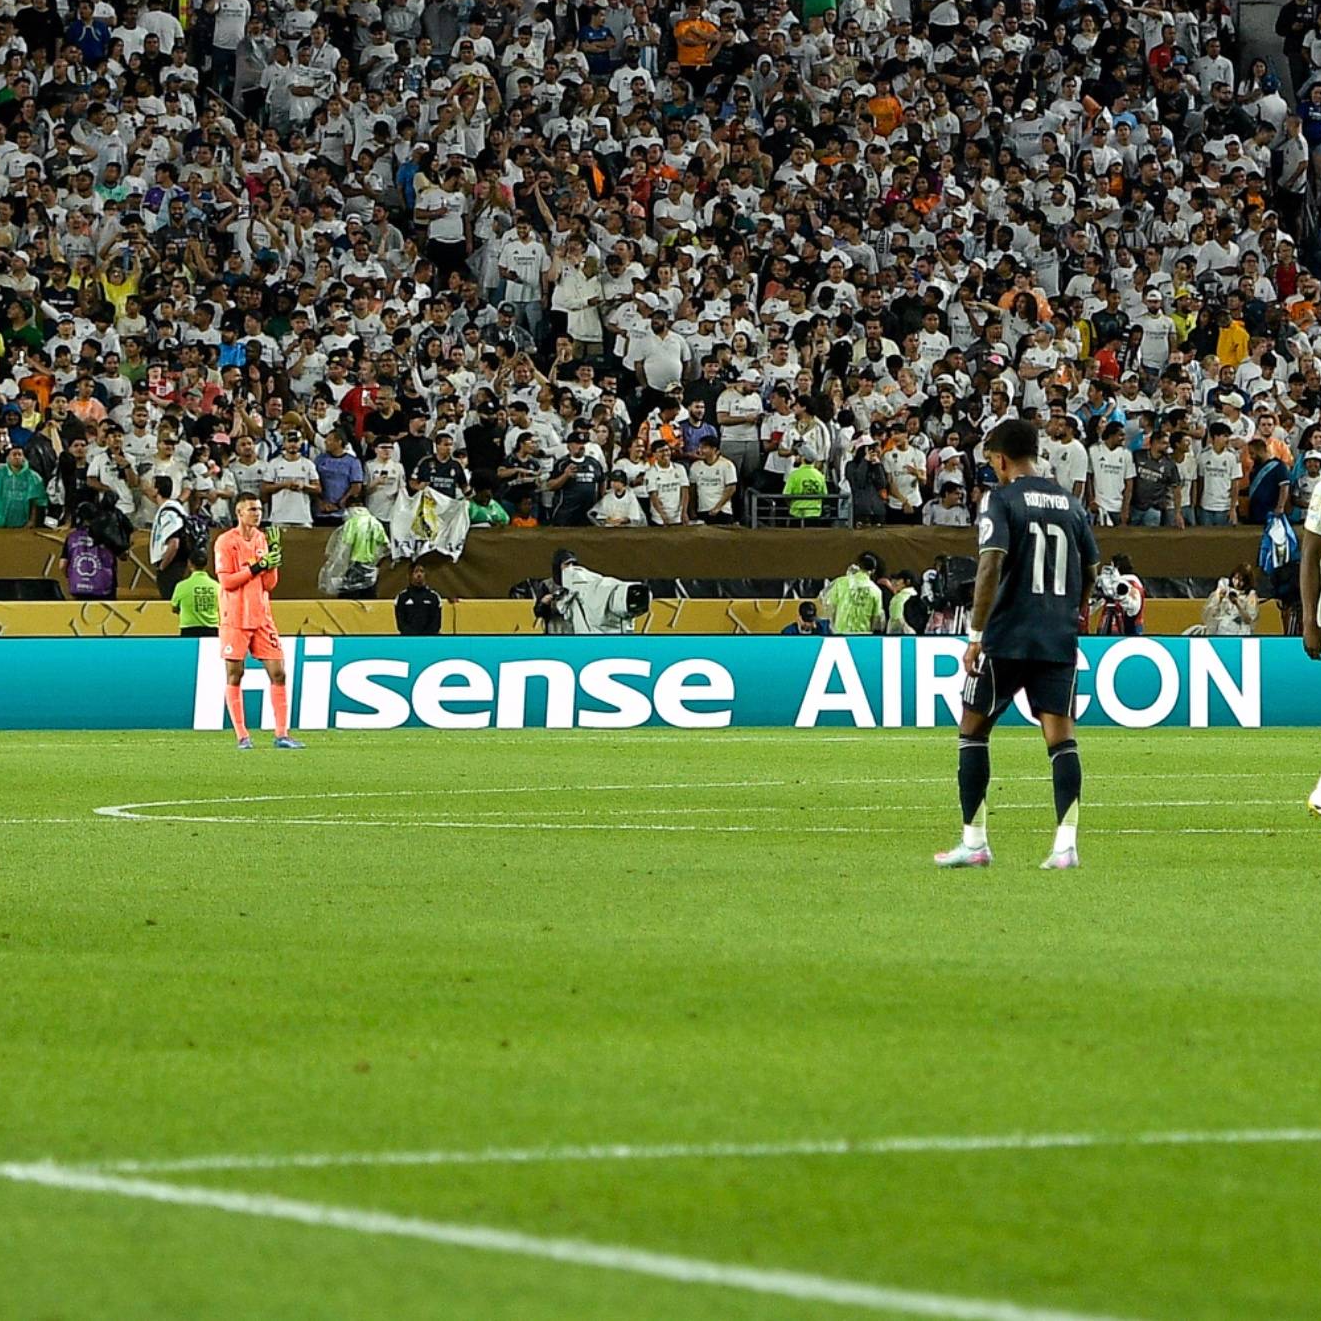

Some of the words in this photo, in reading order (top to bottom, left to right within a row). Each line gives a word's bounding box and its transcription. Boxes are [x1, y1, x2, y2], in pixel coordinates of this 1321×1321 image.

[1023, 491, 1070, 511] RODRYGO
[1028, 521, 1069, 596] 11
[194, 586, 215, 595] CSC
[193, 635, 735, 731] Hisense
[794, 638, 969, 729] AIR
